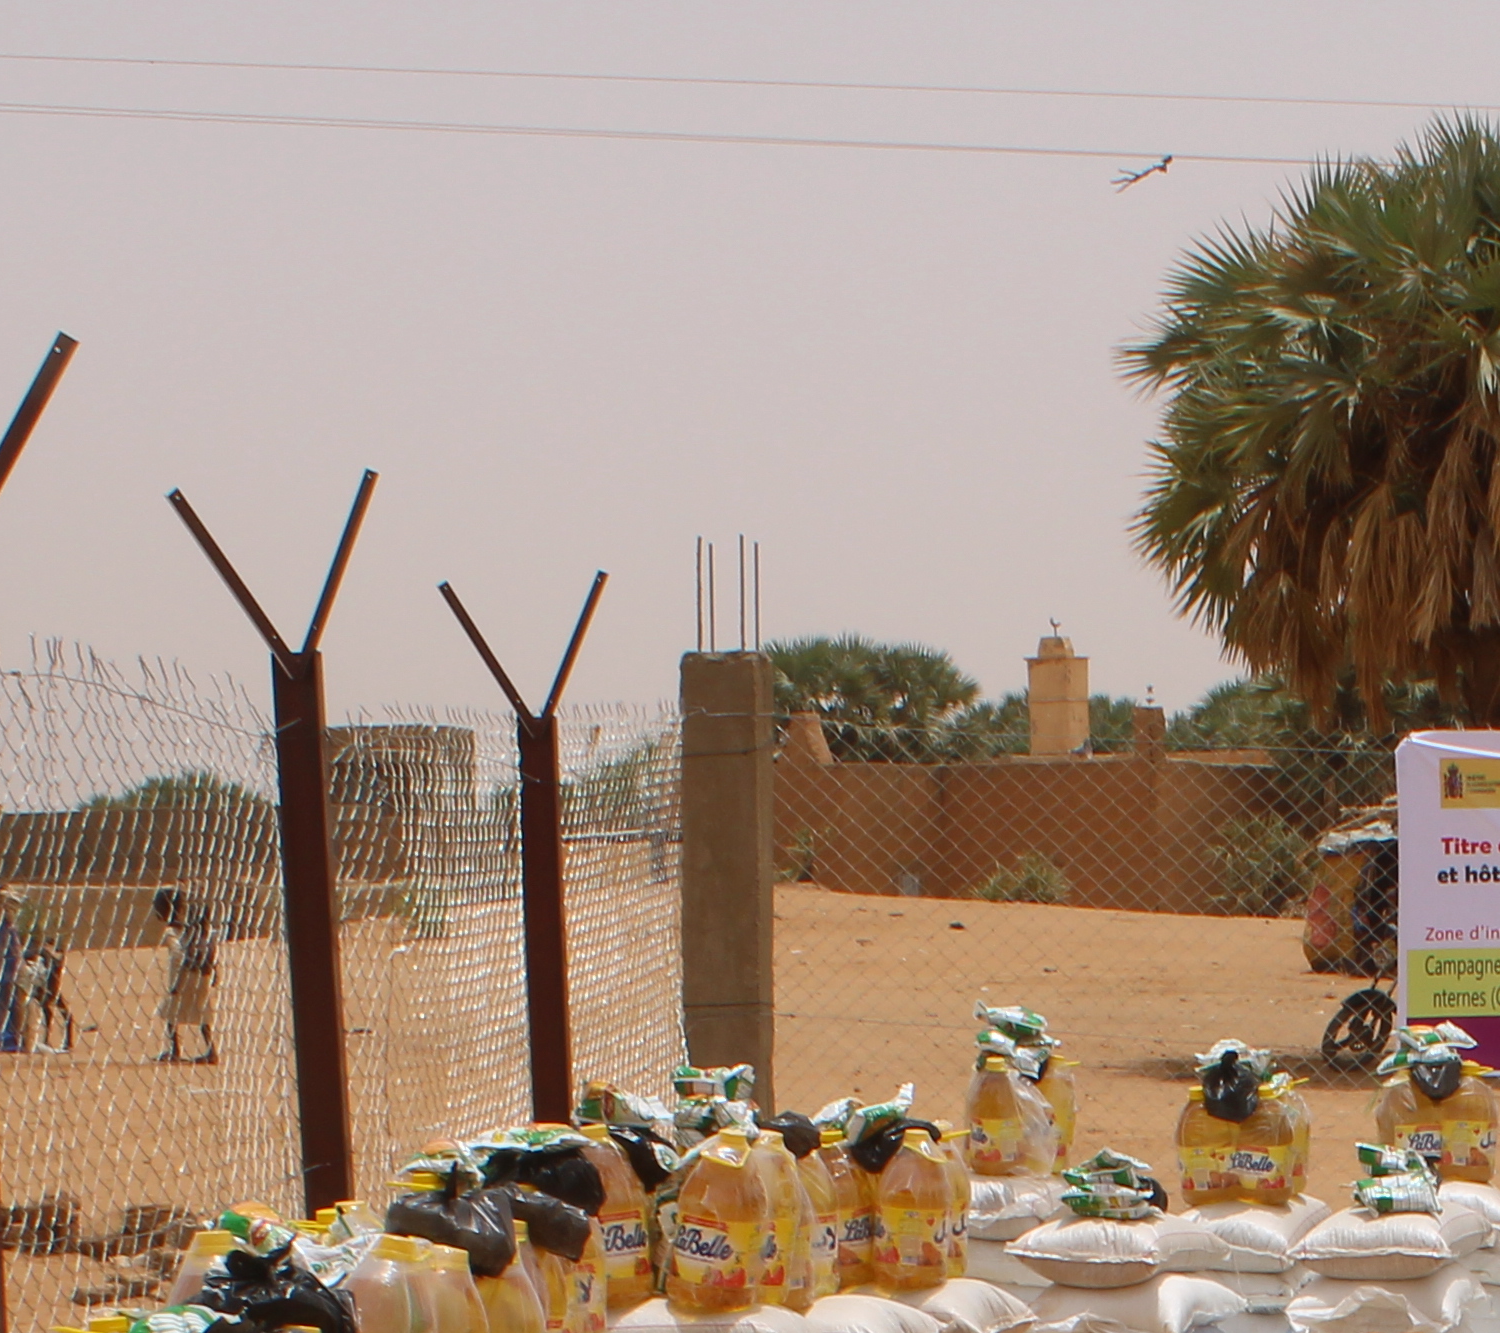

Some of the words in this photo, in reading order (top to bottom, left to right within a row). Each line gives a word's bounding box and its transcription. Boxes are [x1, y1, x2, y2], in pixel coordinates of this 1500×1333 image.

[1441, 837, 1491, 855] Titre
[1437, 867, 1458, 883] et
[1425, 927, 1463, 942] Zone
[1433, 987, 1486, 1007] nternes
